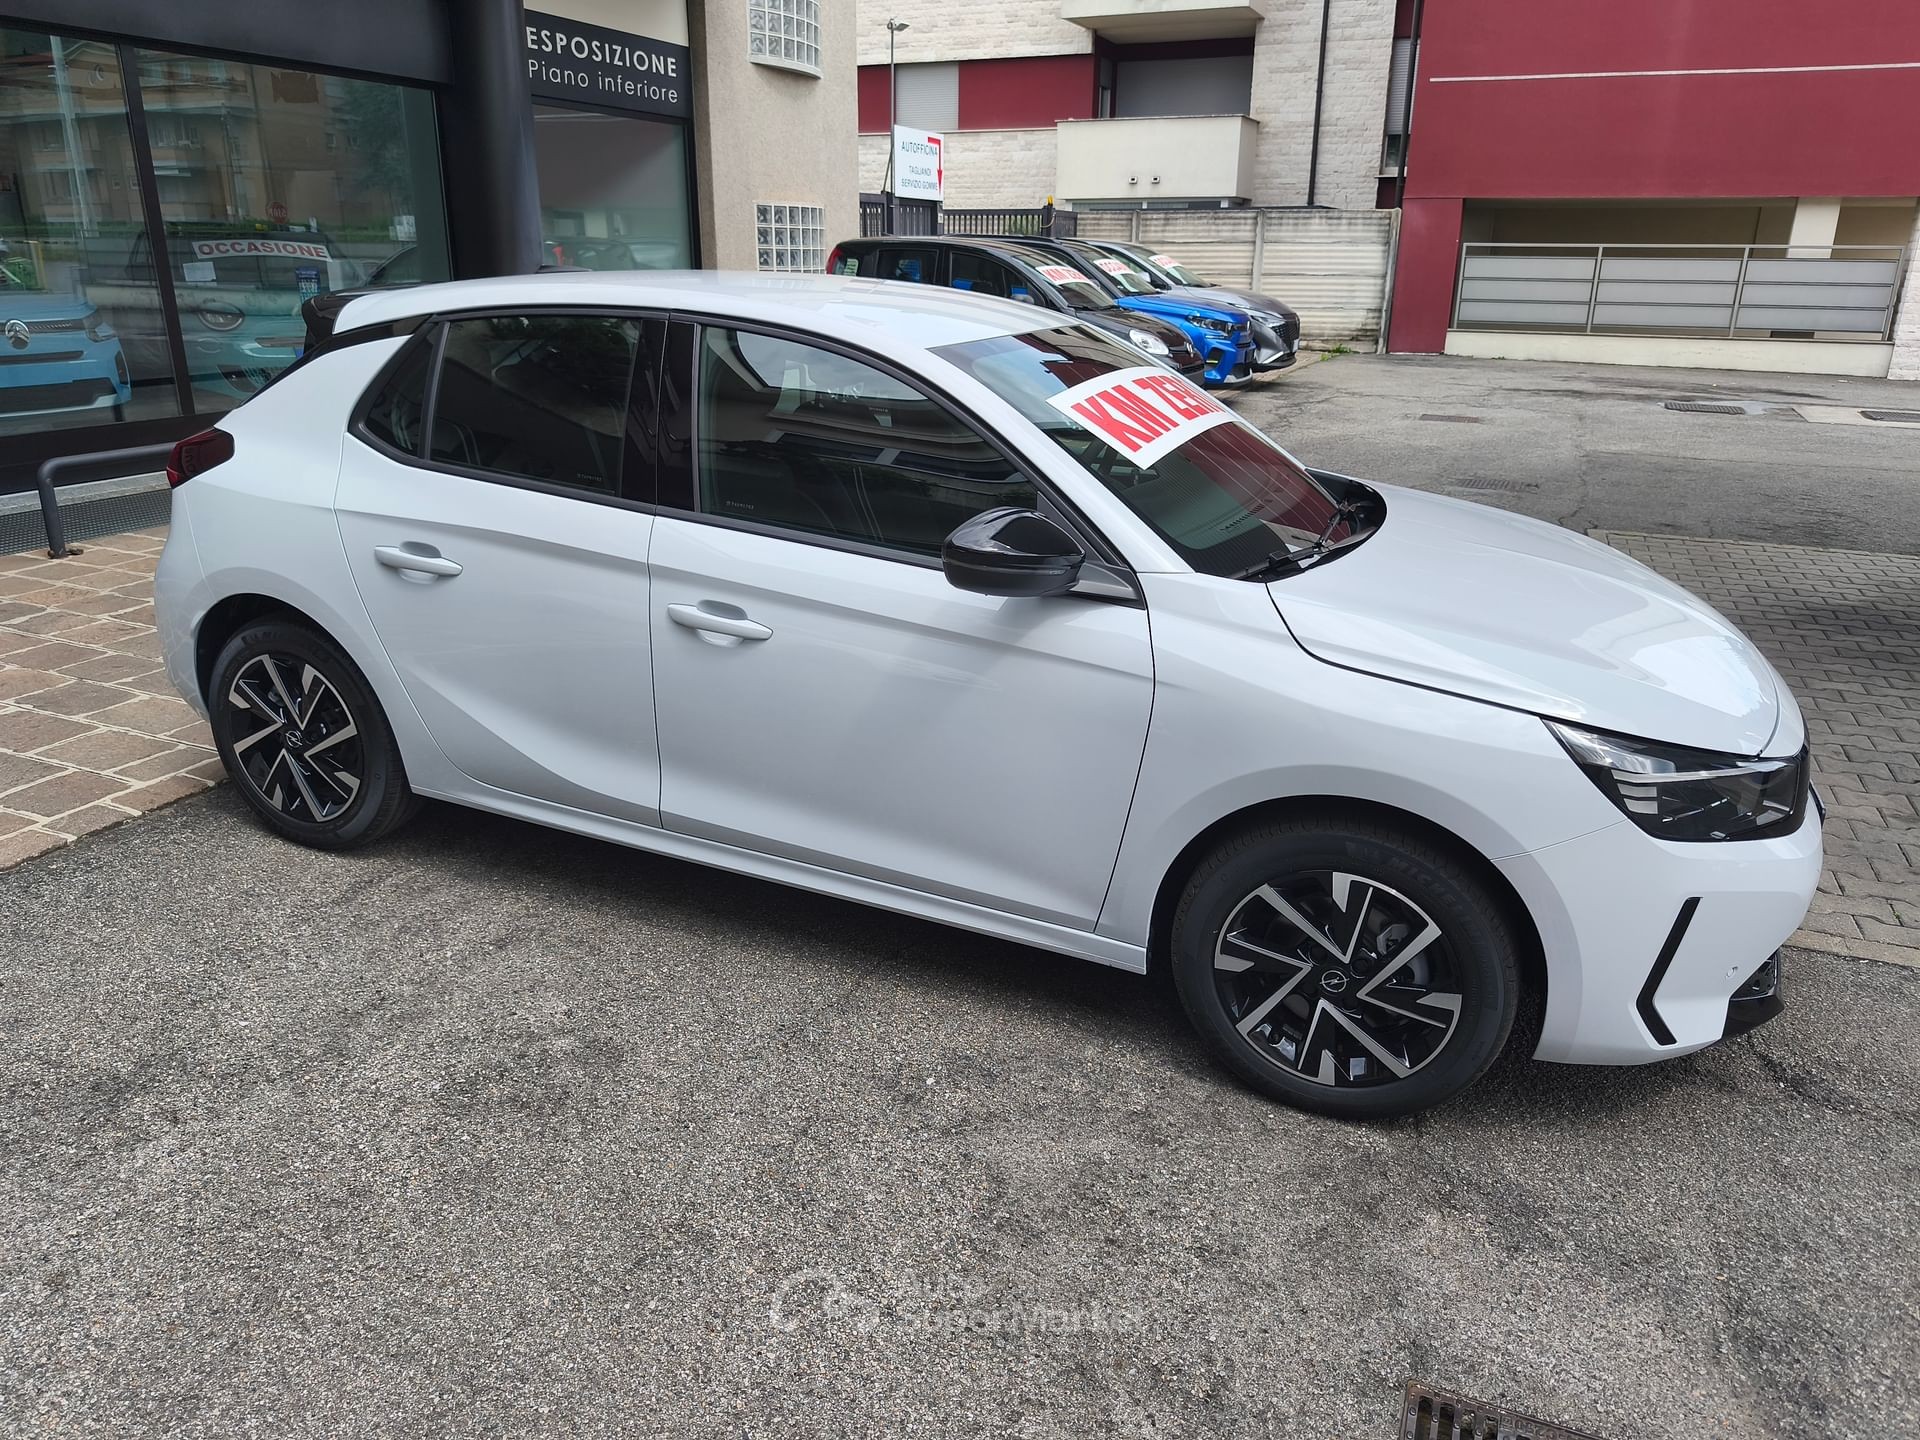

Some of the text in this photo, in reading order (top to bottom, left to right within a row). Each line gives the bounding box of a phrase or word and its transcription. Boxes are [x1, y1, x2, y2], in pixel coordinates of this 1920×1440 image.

[526, 26, 678, 77] ESPOSIZIONE
[528, 59, 678, 103] Piano inferiore
[901, 141, 938, 156] AUTOFFICINA
[198, 241, 328, 258] OCCASIONE
[1071, 375, 1226, 453] KM ZER
